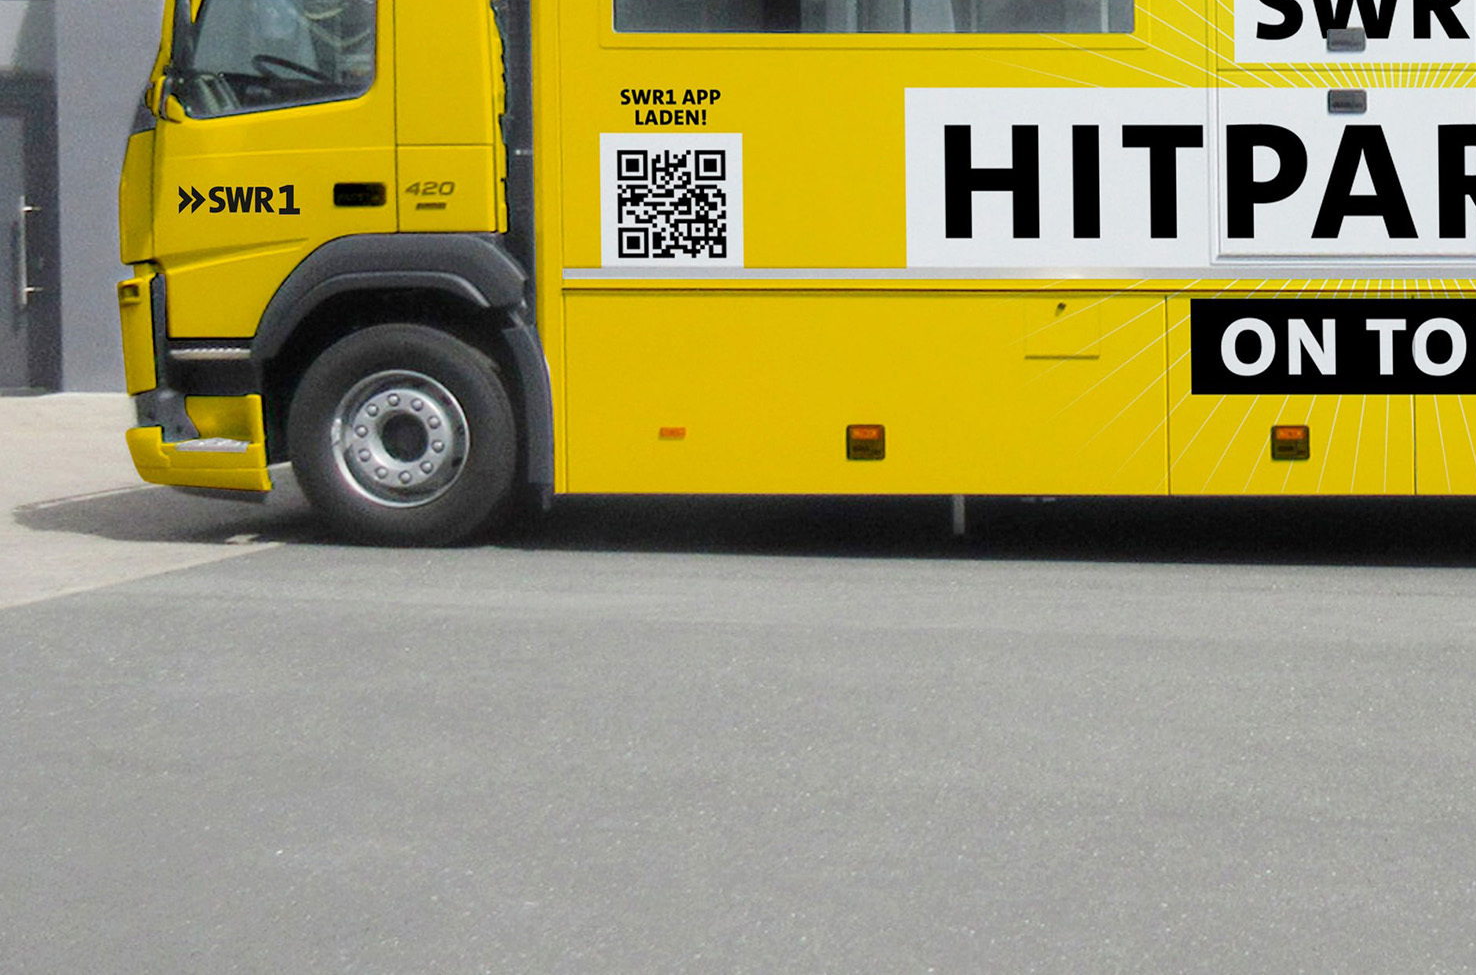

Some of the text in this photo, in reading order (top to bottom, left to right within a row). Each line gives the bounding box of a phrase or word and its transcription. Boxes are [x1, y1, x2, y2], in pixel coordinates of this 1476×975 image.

[620, 88, 721, 105] SWR1 APP
[635, 109, 707, 126] LADEN!
[405, 181, 456, 196] 420
[1220, 317, 1337, 377] ON
